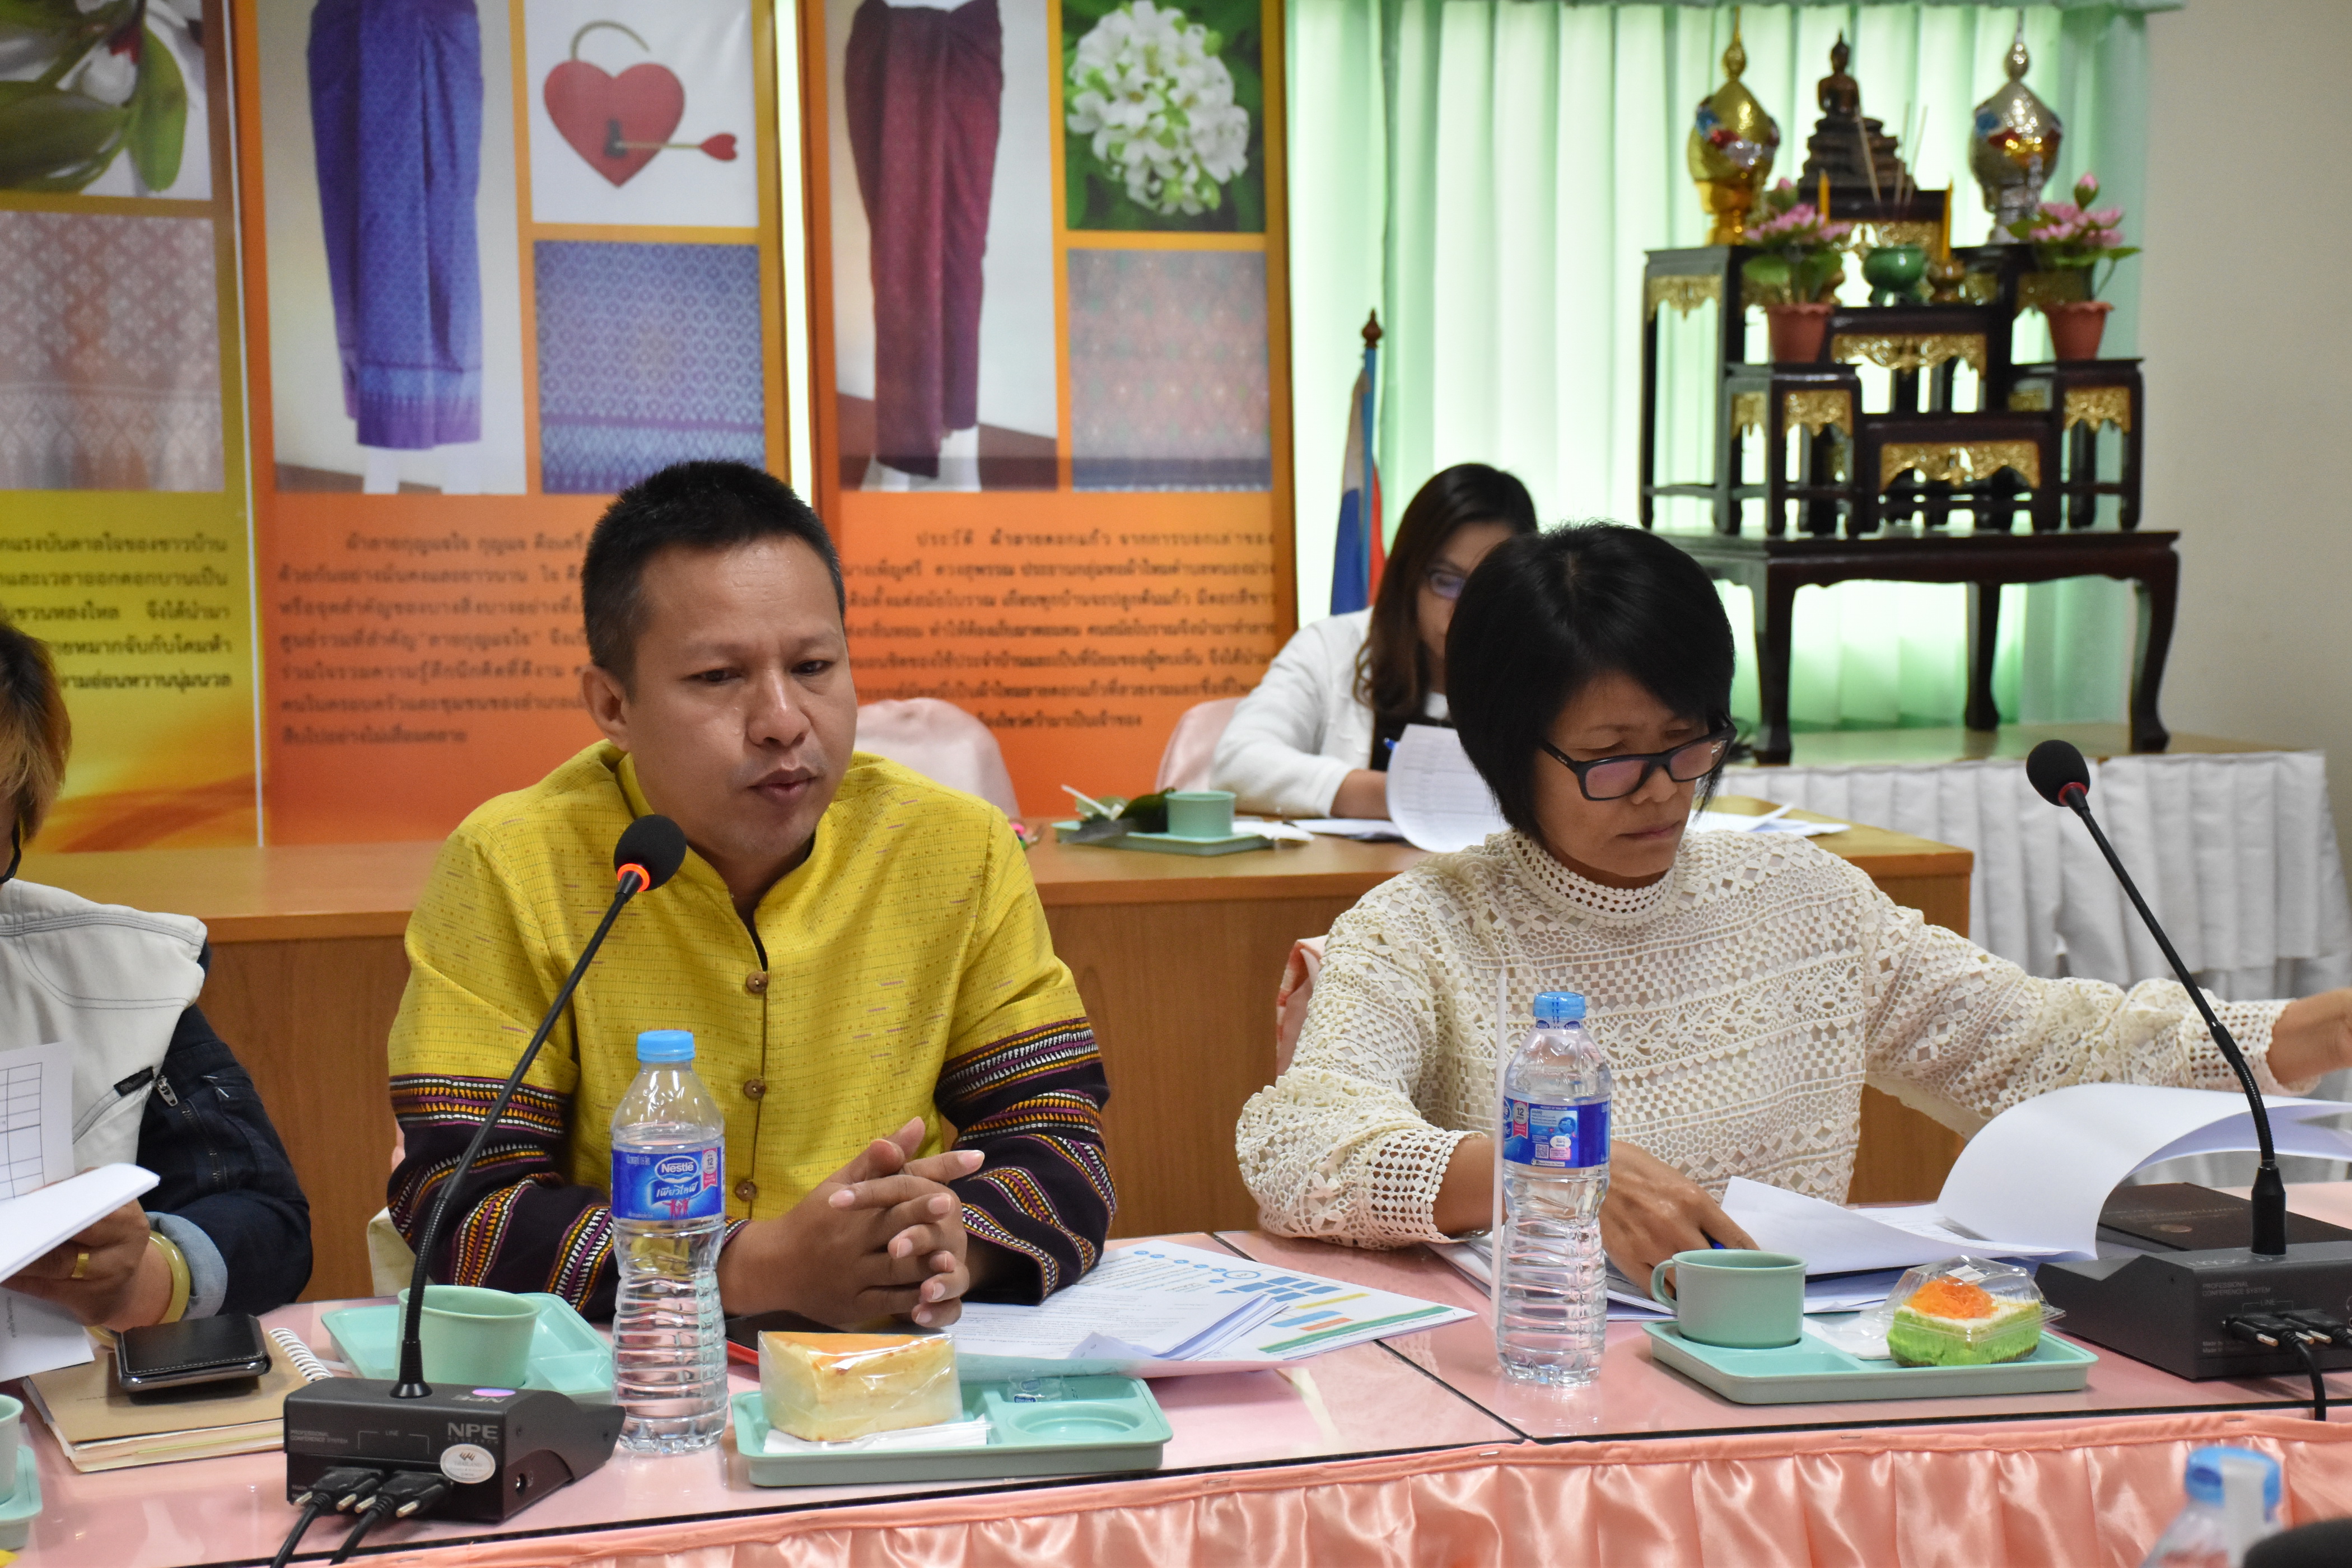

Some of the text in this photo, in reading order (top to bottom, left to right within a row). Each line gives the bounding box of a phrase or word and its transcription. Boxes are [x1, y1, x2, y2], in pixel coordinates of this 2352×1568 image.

[1516, 1107, 1524, 1116] 12
[707, 1157, 713, 1166] 12
[661, 1161, 694, 1173] Nestlé
[447, 1422, 498, 1440] NPE
